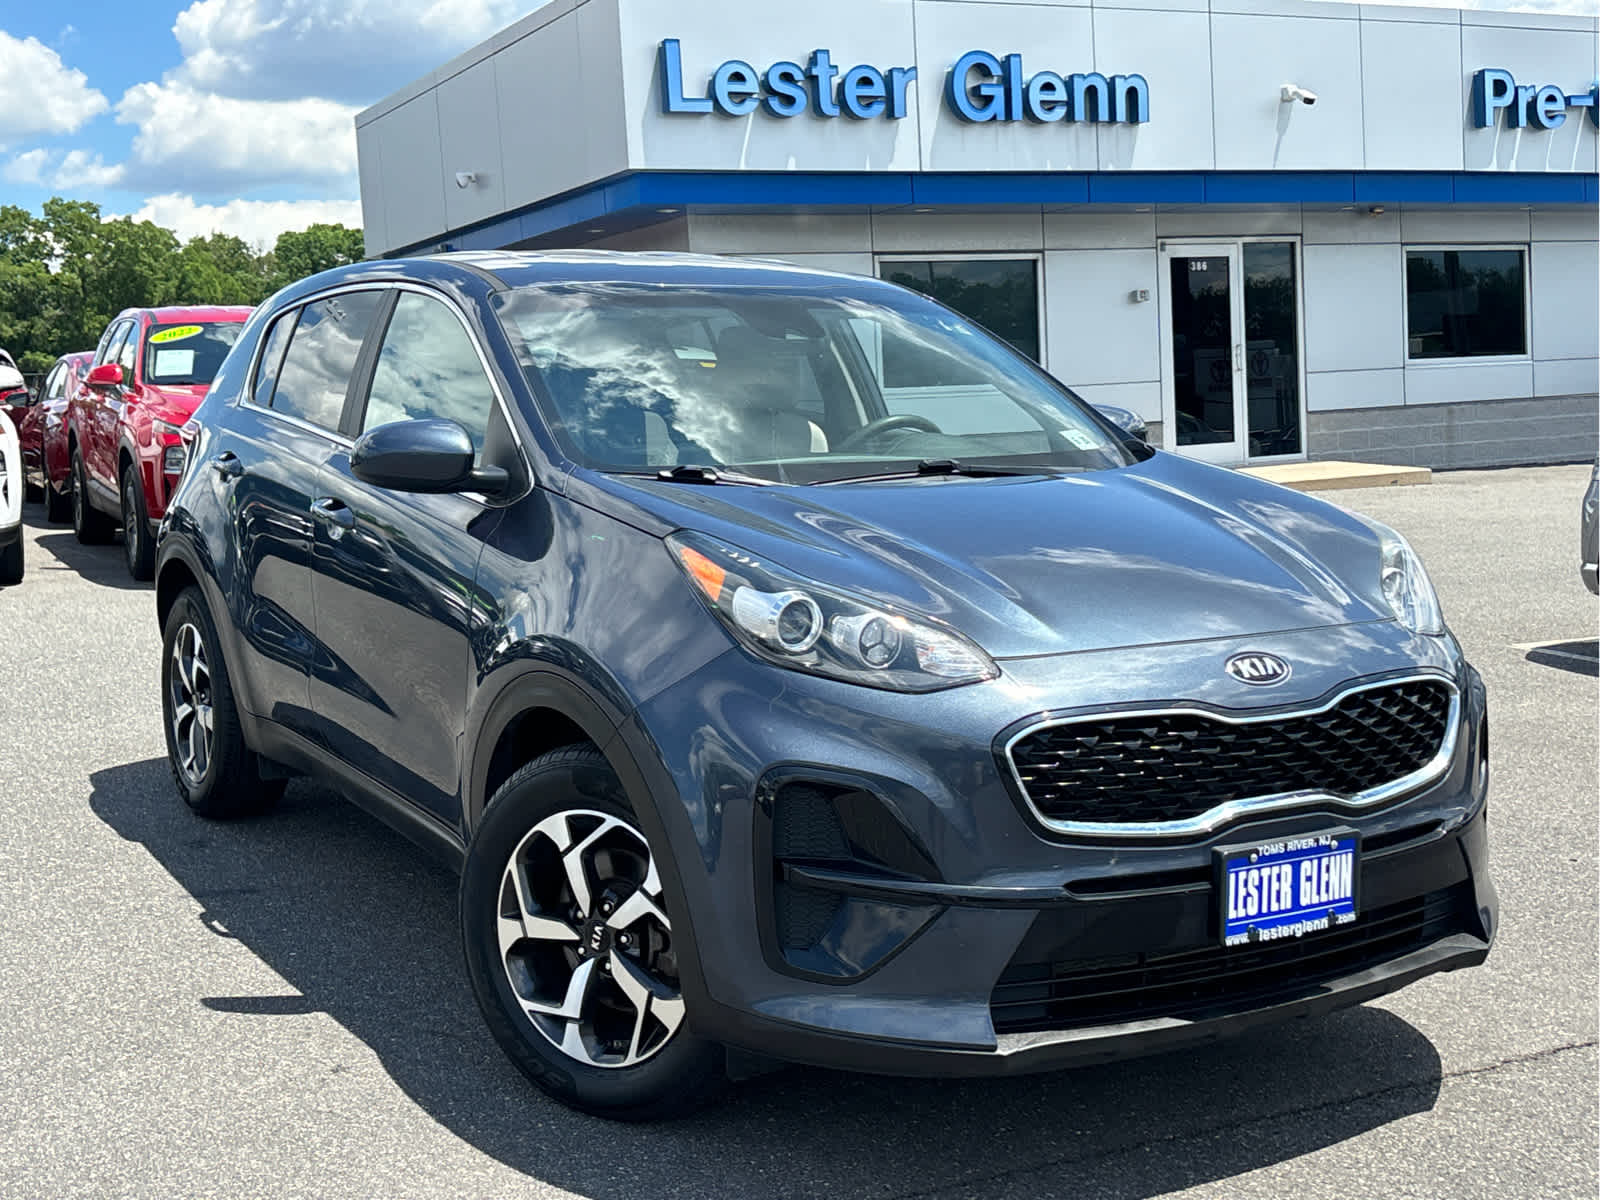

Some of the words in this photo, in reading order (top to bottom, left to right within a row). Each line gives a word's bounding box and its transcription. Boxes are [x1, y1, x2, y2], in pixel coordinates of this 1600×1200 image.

[659, 38, 918, 119] Lester
[947, 50, 1149, 124] Glenn
[1473, 68, 1599, 129] Pre-
[1233, 656, 1283, 679] KIA
[1257, 843, 1286, 857] TOMS
[1318, 835, 1332, 846] NJ
[1228, 863, 1293, 920] LESTER
[1299, 853, 1354, 906] GLENN
[591, 926, 604, 950] KIA
